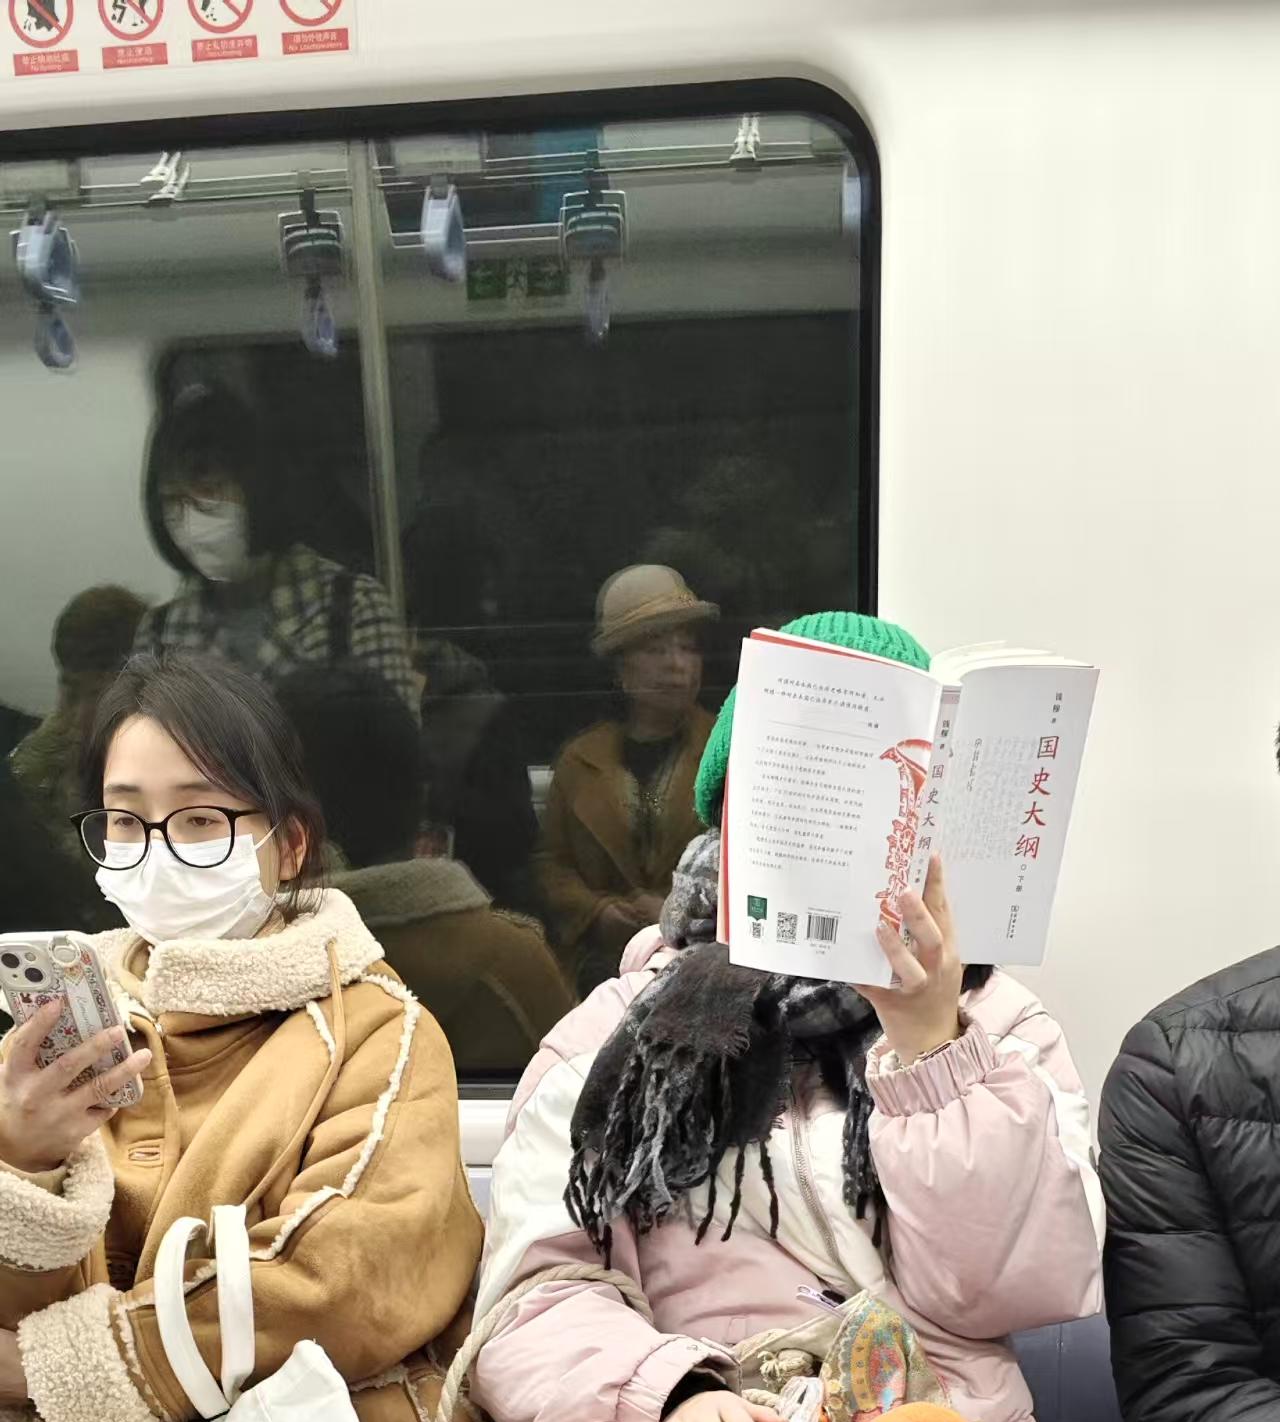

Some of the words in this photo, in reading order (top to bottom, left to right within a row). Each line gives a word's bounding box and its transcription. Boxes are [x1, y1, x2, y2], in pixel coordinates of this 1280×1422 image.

[918, 764, 945, 851] 国史大纲
[1014, 735, 1059, 860] 国史大纲
